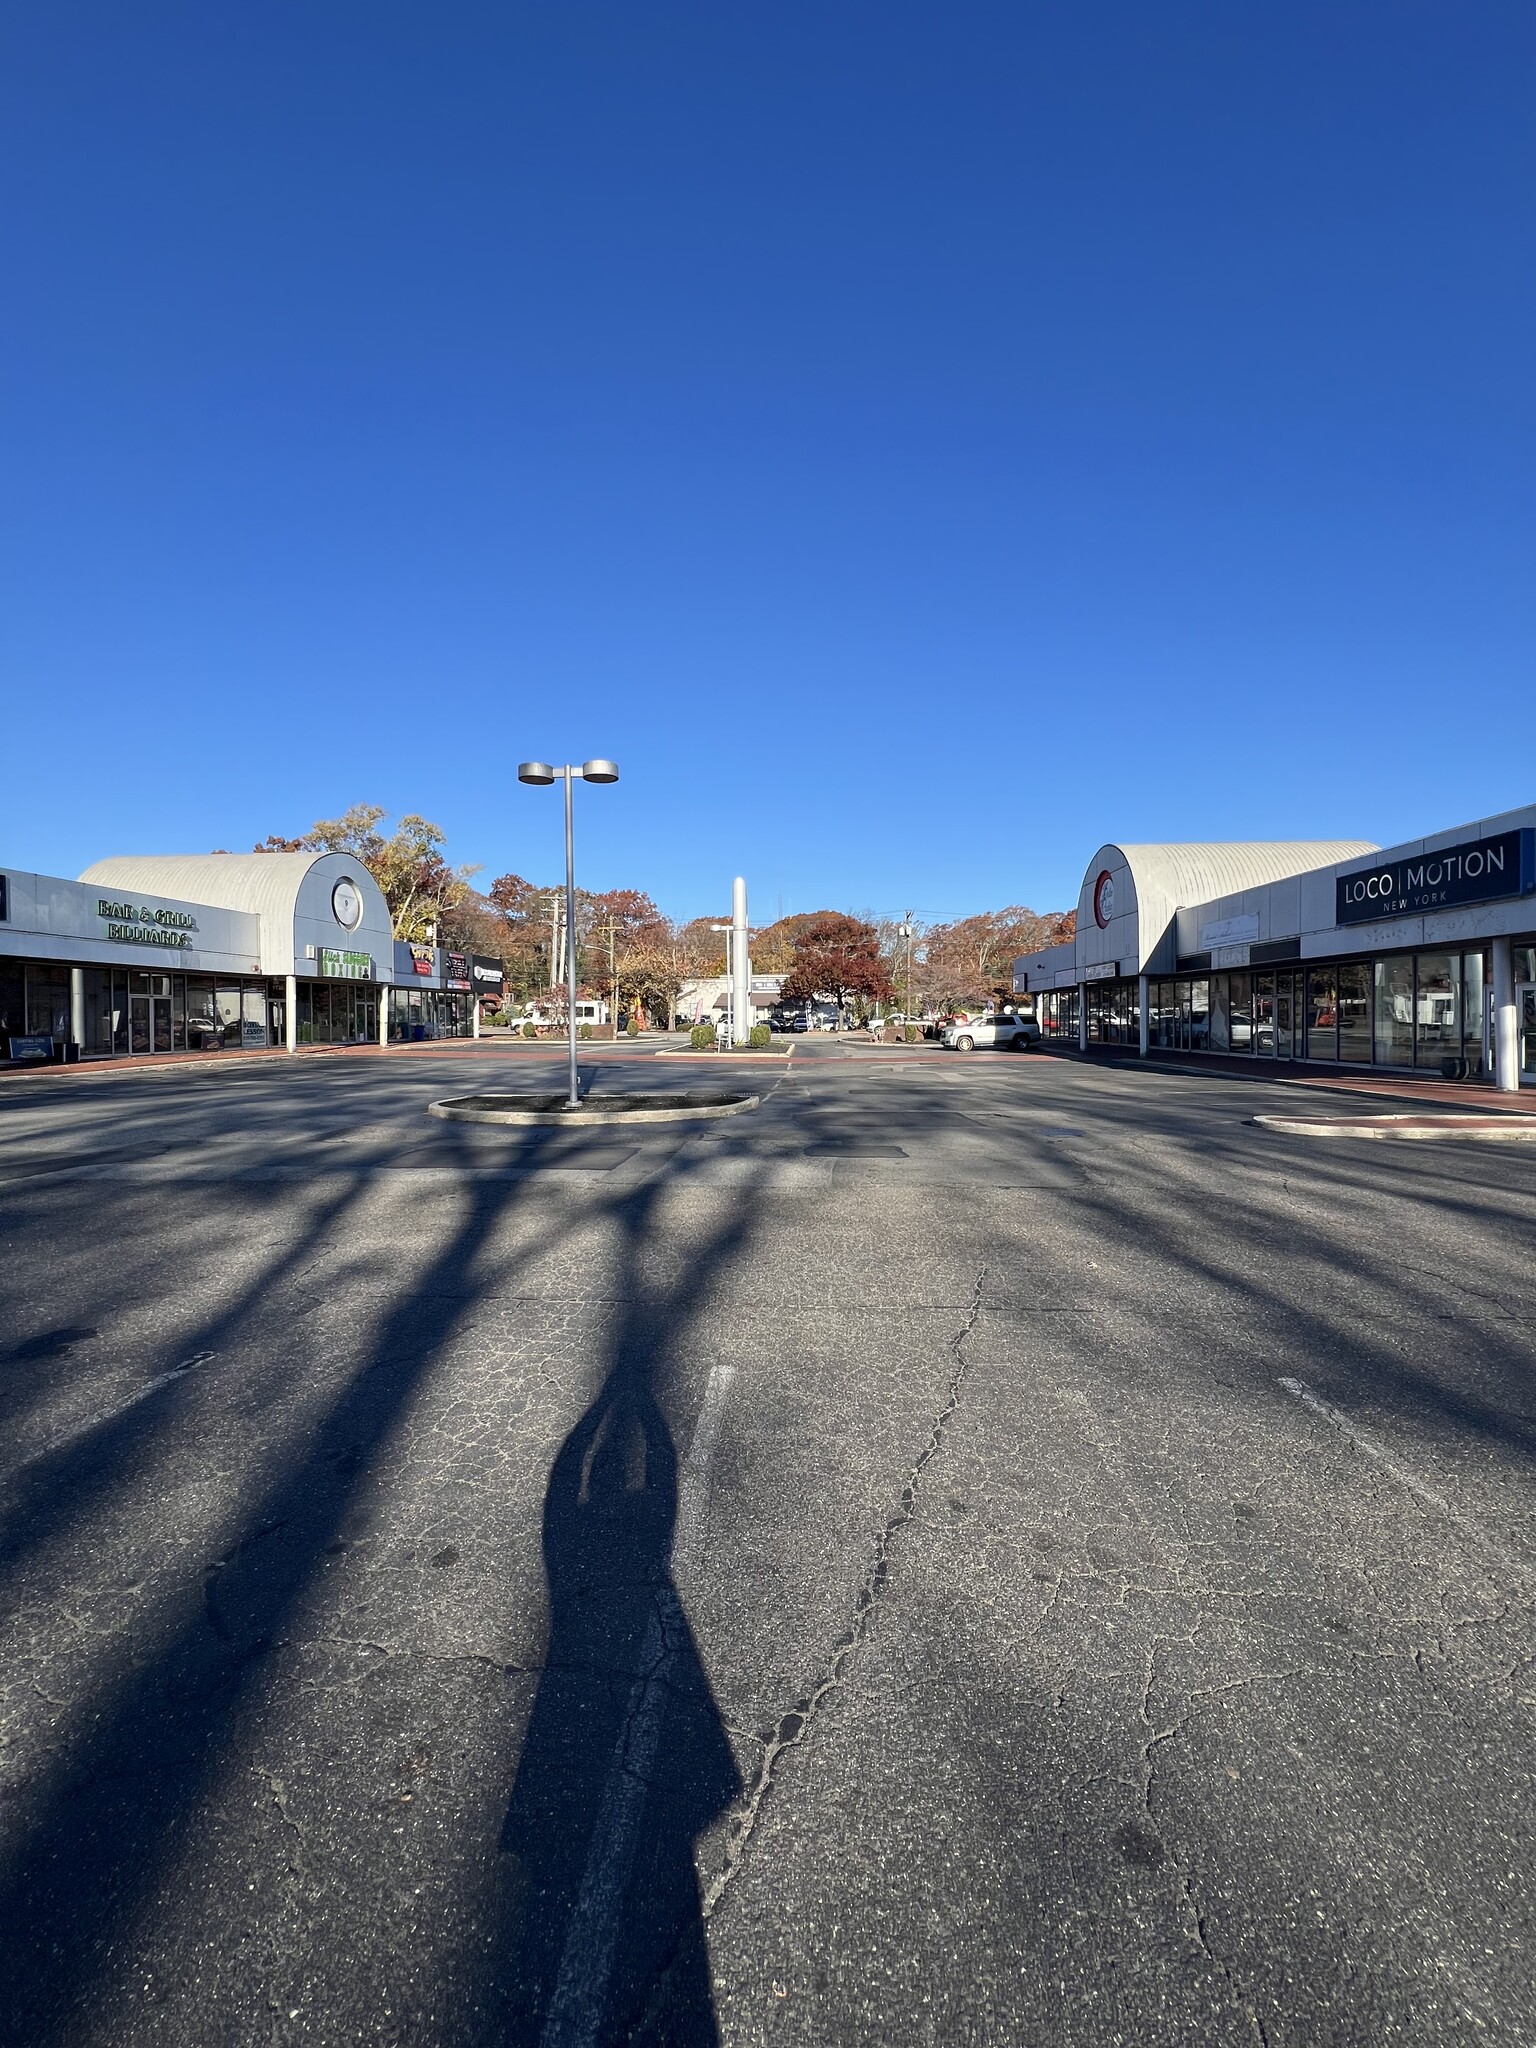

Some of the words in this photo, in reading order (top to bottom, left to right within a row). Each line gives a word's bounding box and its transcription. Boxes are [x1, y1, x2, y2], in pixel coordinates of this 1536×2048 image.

[1345, 873, 1393, 904] LOCO
[1407, 845, 1505, 891] MOTION
[1383, 898, 1408, 912] NEW
[1414, 890, 1448, 906] YORK
[98, 900, 135, 921] BAR
[138, 906, 150, 923] &
[154, 909, 194, 929] GRILL
[108, 923, 188, 946] BILLIARDS
